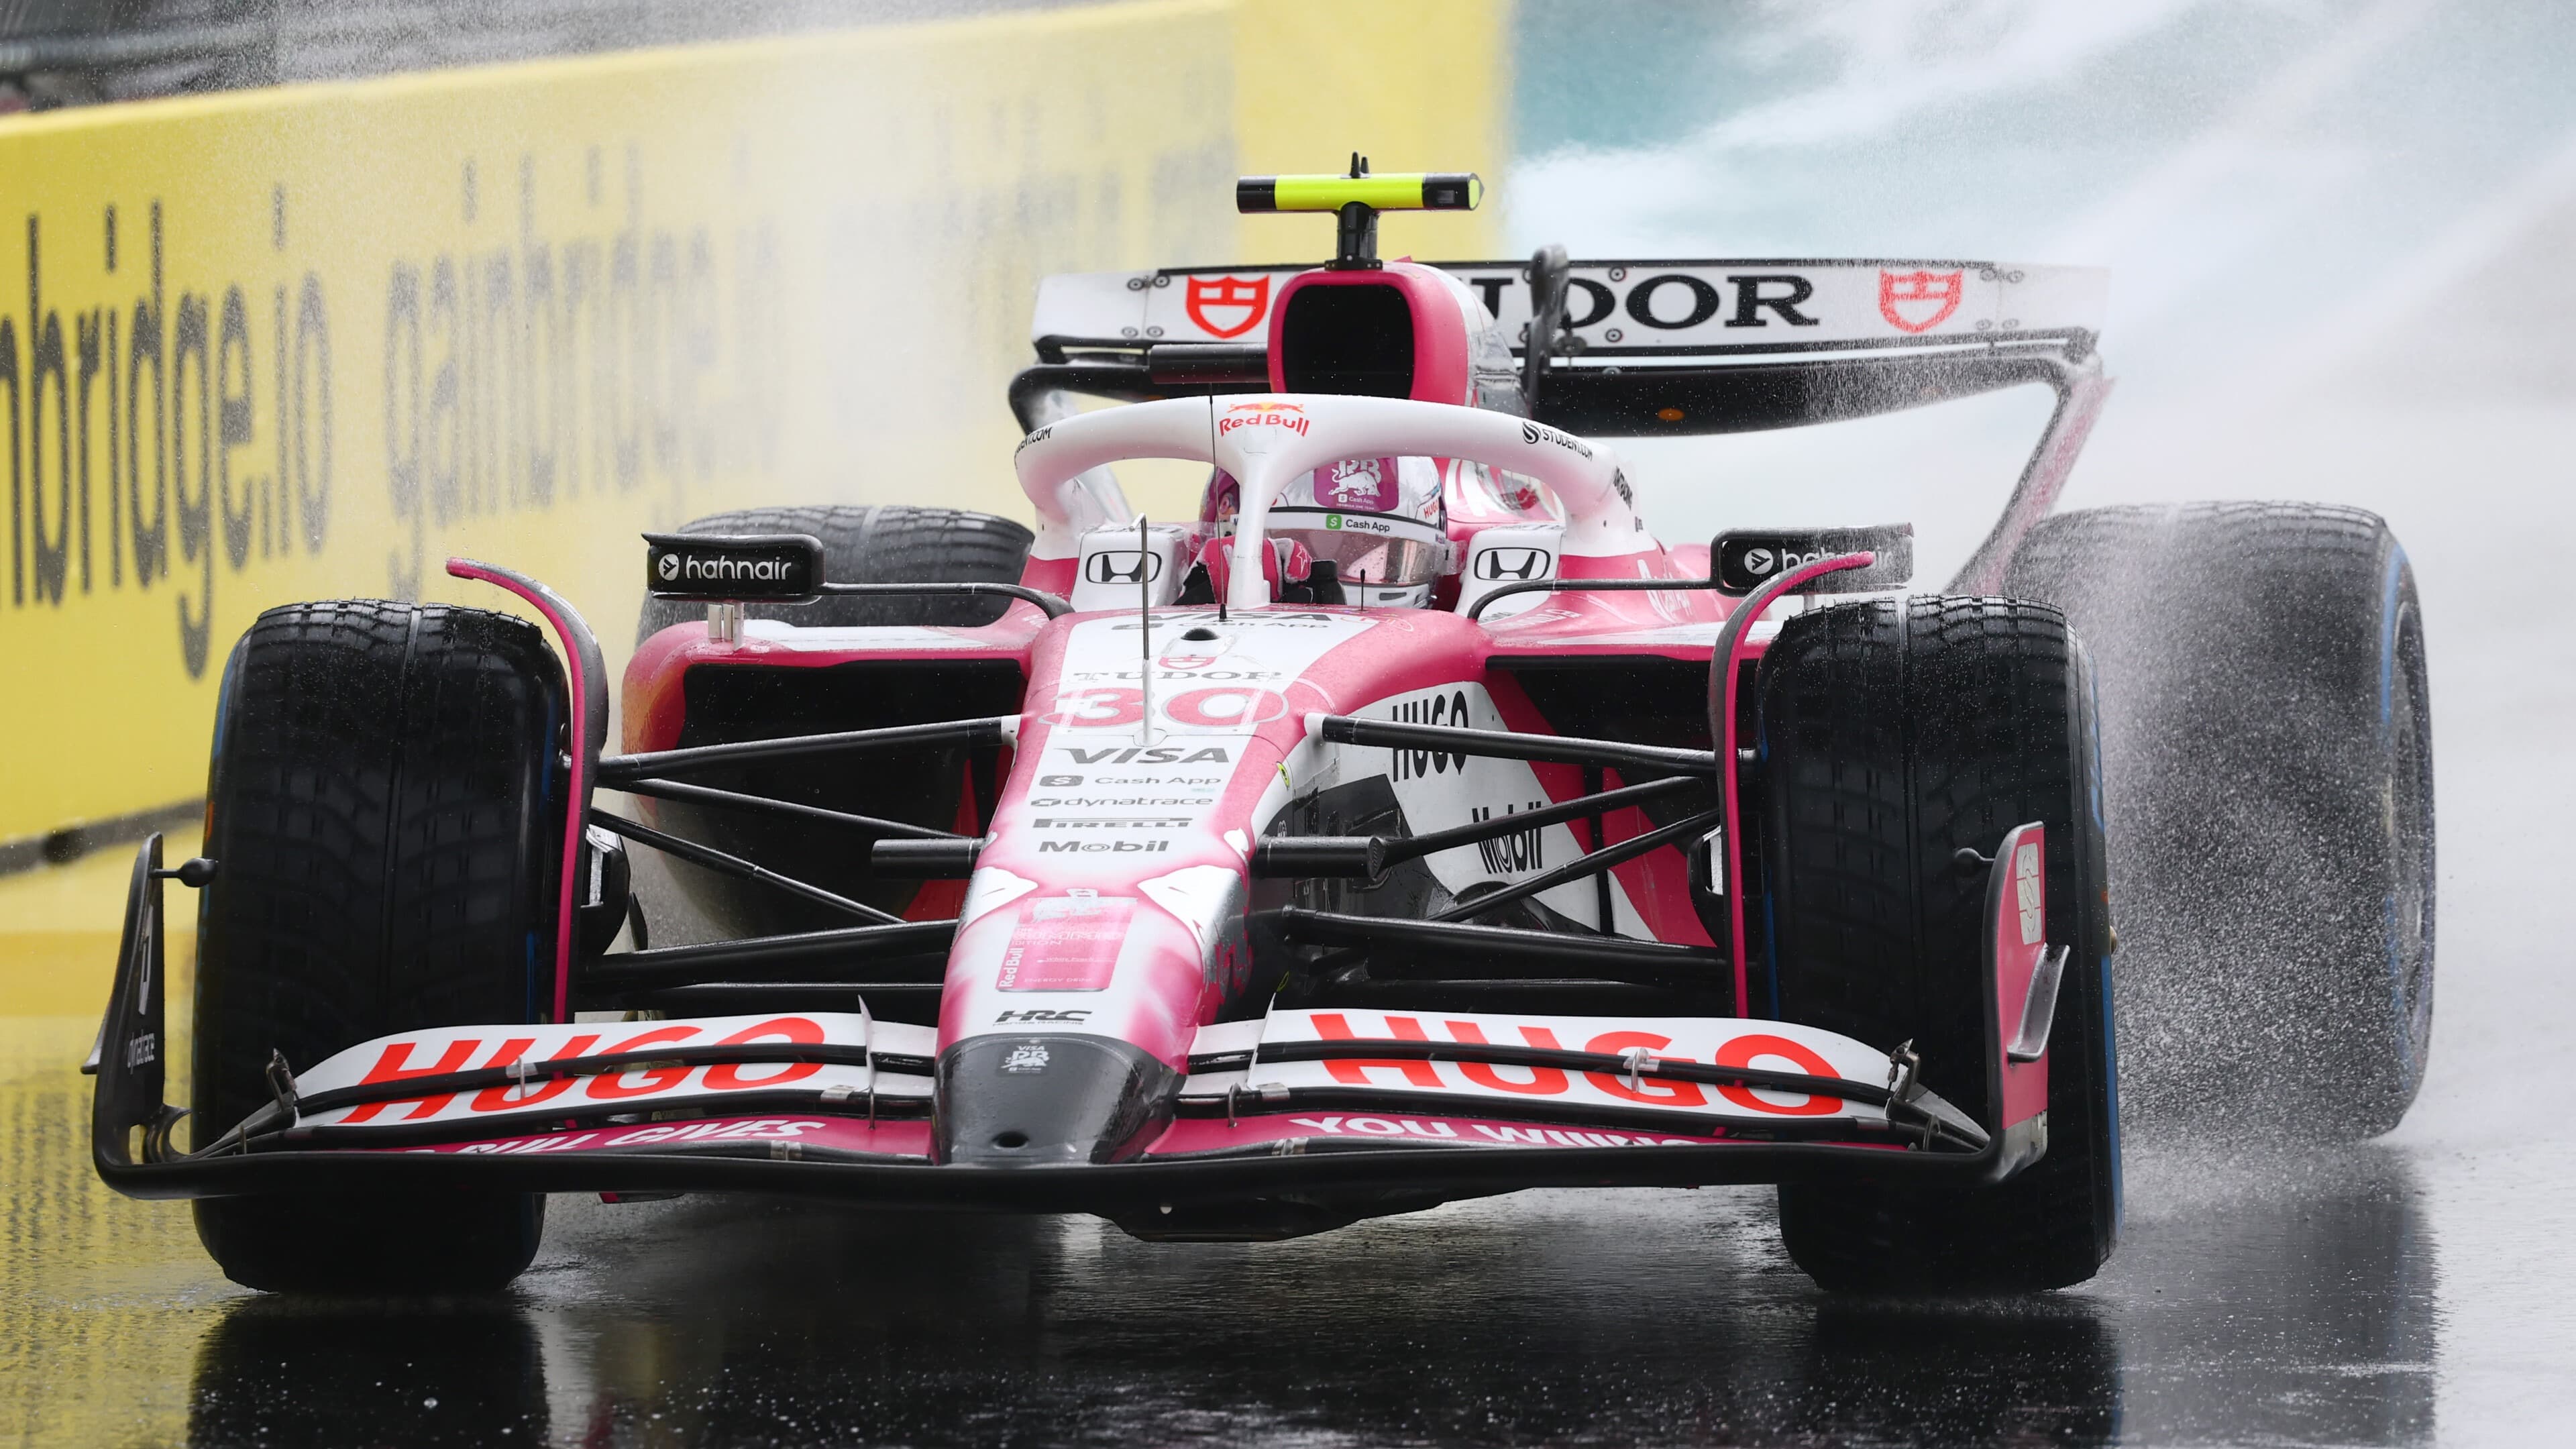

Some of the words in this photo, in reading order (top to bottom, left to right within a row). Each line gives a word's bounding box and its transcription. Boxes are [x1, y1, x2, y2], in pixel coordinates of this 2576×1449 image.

[1219, 414, 1262, 437] Red
[1265, 415, 1310, 437] Bull
[1542, 429, 1593, 462] STUDENT.COM
[1346, 519, 1371, 530] Cash
[1373, 521, 1390, 533] App
[686, 555, 792, 580] hahnair
[1038, 686, 1289, 727] 30
[1055, 747, 1229, 764] VISA
[1167, 777, 1222, 786] App
[1064, 798, 1213, 807] dynatrace
[1038, 841, 1169, 853] Mobil
[1006, 947, 1025, 967] Bull
[999, 967, 1018, 987] Red
[995, 1010, 1093, 1023] HRC
[338, 1017, 826, 1124] HUGO
[1309, 1013, 1843, 1116] HUGO
[604, 1120, 826, 1146] GIVES
[1290, 1116, 1458, 1138] YOU
